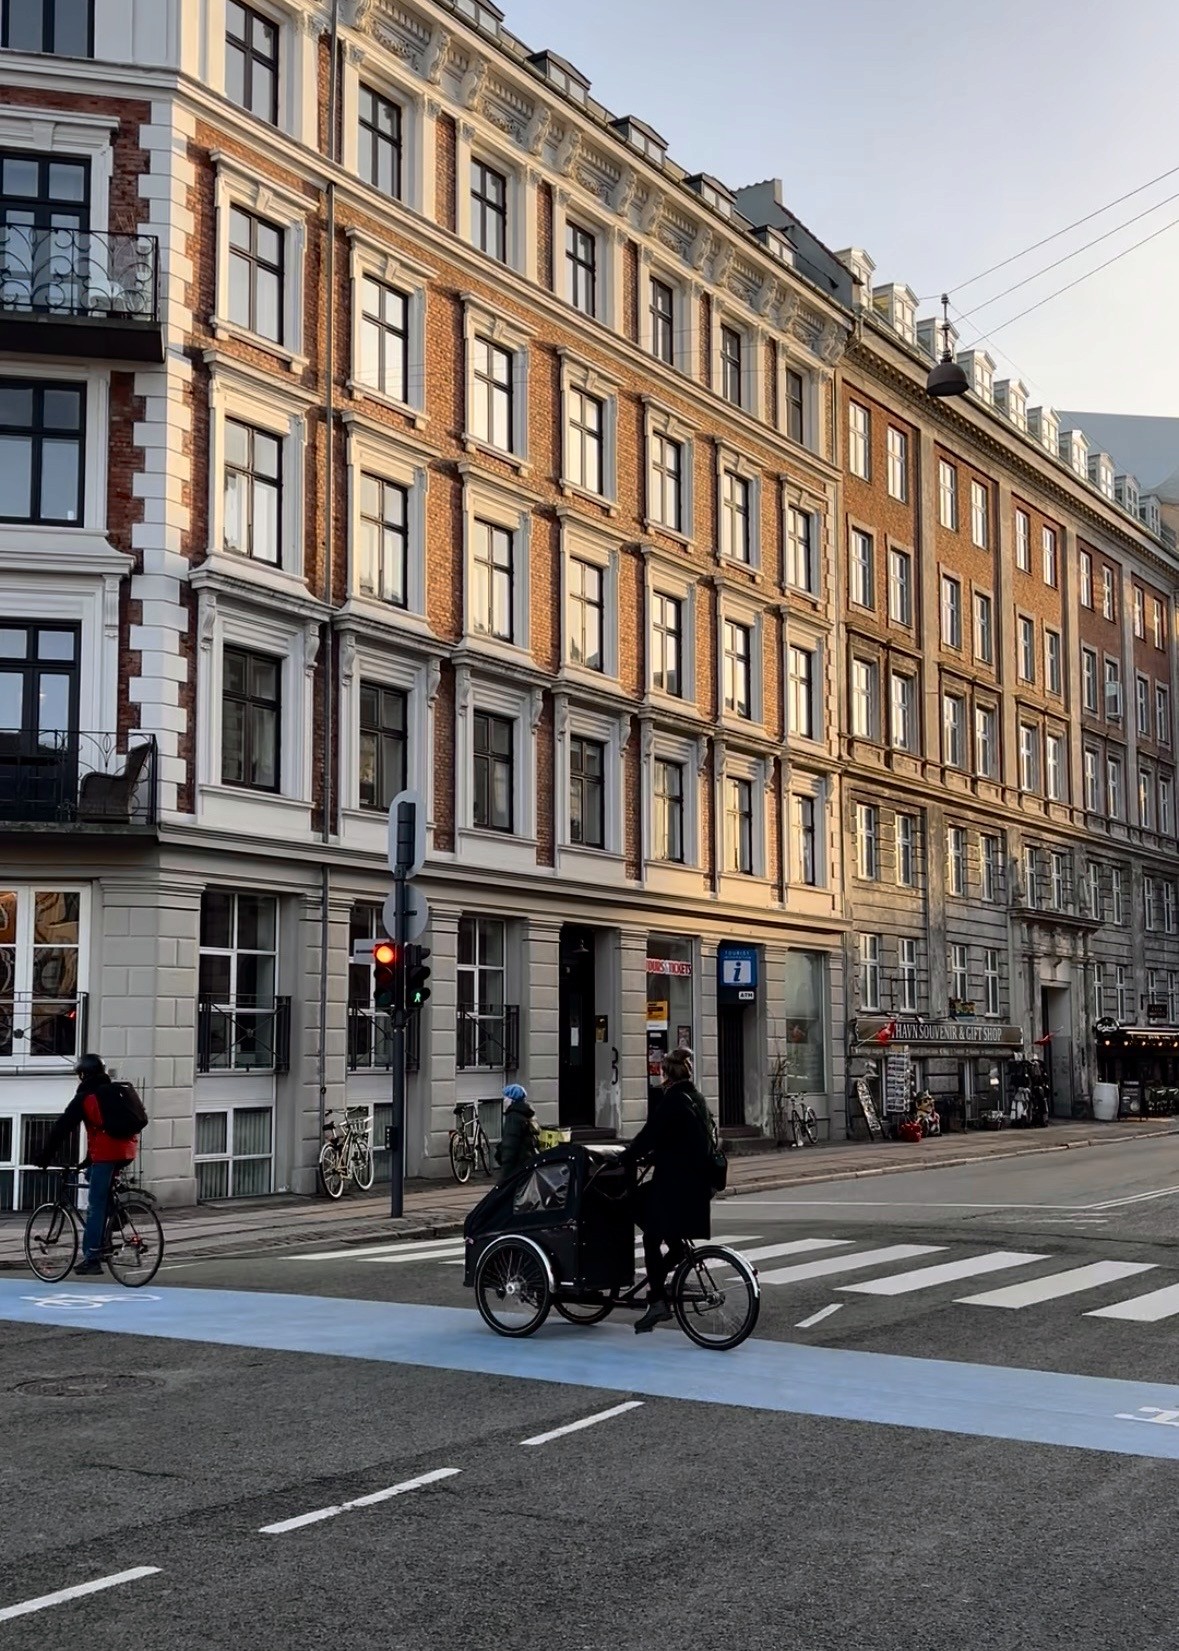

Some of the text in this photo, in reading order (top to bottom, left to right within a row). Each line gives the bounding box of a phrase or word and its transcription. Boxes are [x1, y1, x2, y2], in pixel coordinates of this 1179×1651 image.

[890, 1023, 1002, 1042] HAVN SOUVENIR & GIFT SHOP
